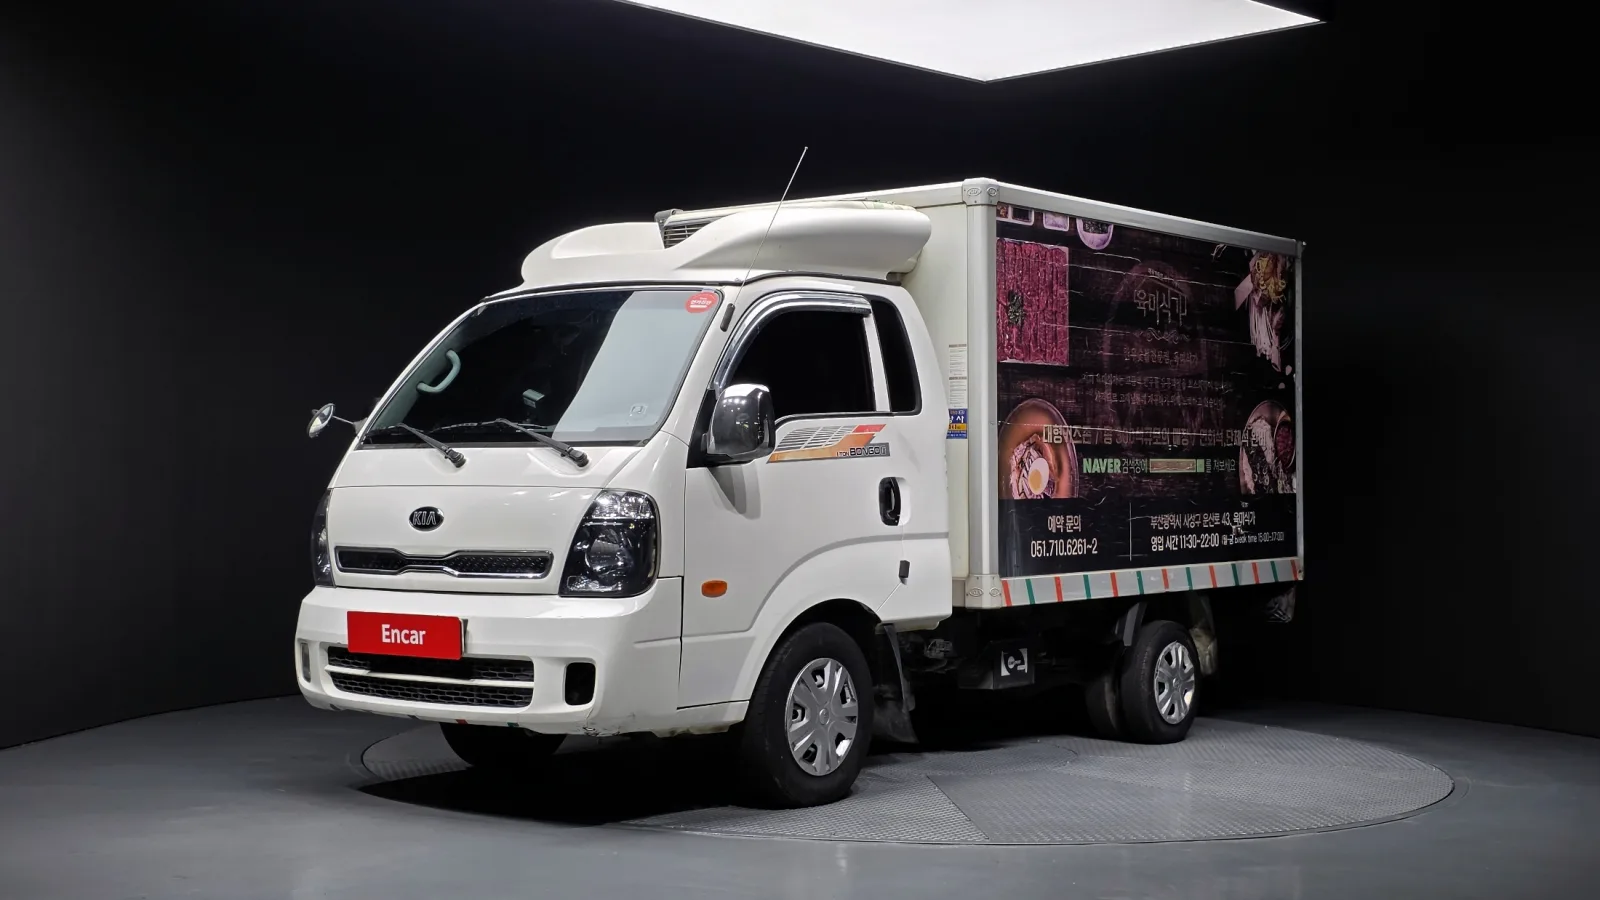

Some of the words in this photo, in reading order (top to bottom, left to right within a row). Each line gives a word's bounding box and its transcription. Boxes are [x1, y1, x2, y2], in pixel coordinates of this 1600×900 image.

[1134, 289, 1187, 326] 육미식가
[1083, 458, 1121, 473] NAVER
[1122, 458, 1147, 473] 검색창에
[412, 510, 437, 525] KIA
[1047, 515, 1064, 533] 예약
[1065, 514, 1082, 533] 문의
[1150, 513, 1182, 529] 부산광역시
[1203, 512, 1220, 527] 운산로
[1233, 510, 1256, 526] 육미식가
[1030, 537, 1098, 557] 051.710.6261~2
[1150, 535, 1164, 551] 영업
[1165, 534, 1178, 550] 시간
[1180, 533, 1220, 549] 11:30~22:00
[381, 624, 426, 645] Encar
